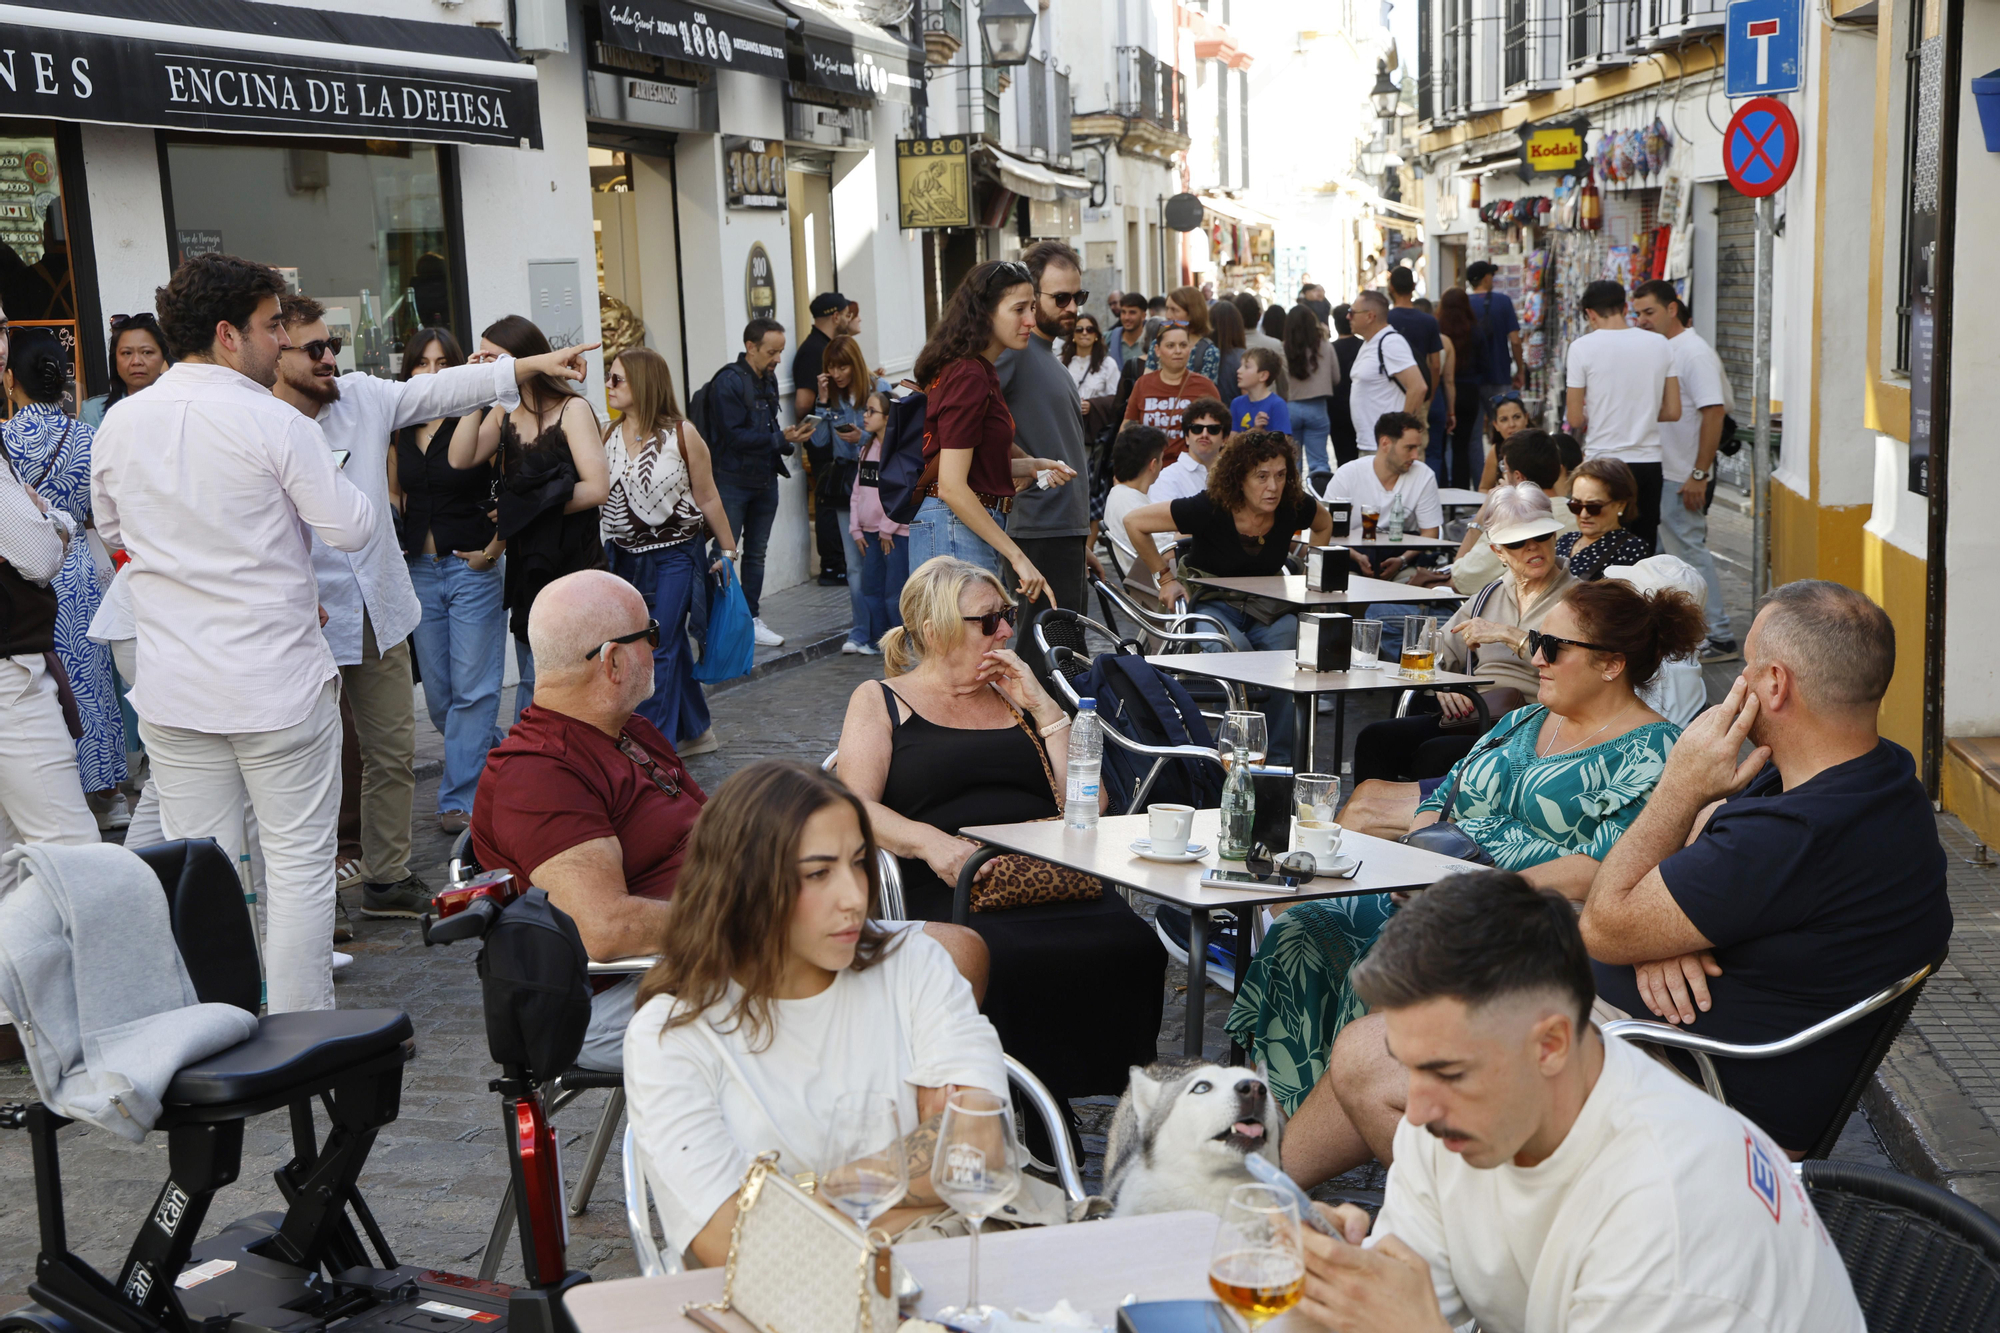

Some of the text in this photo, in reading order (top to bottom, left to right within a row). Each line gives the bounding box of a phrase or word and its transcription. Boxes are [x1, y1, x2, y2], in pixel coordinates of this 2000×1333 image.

[693, 12, 708, 25] CASA
[678, 20, 733, 62] 1880
[733, 37, 759, 54] ARTESANOS
[165, 65, 509, 128] ENCINA DE LA DEHESA
[634, 82, 679, 105] ARTESANOS
[750, 139, 766, 153] CASA
[898, 139, 965, 156] 1880
[1531, 142, 1578, 158] Kodak
[729, 151, 786, 195] 1880
[752, 257, 767, 277] 300
[1144, 397, 1191, 411] Belle
[1143, 411, 1183, 427] Fièr
[947, 1153, 981, 1170] GRAN
[952, 1168, 974, 1182] VIA
[160, 1184, 176, 1215] MOBILITY
[156, 1189, 187, 1234] ican
